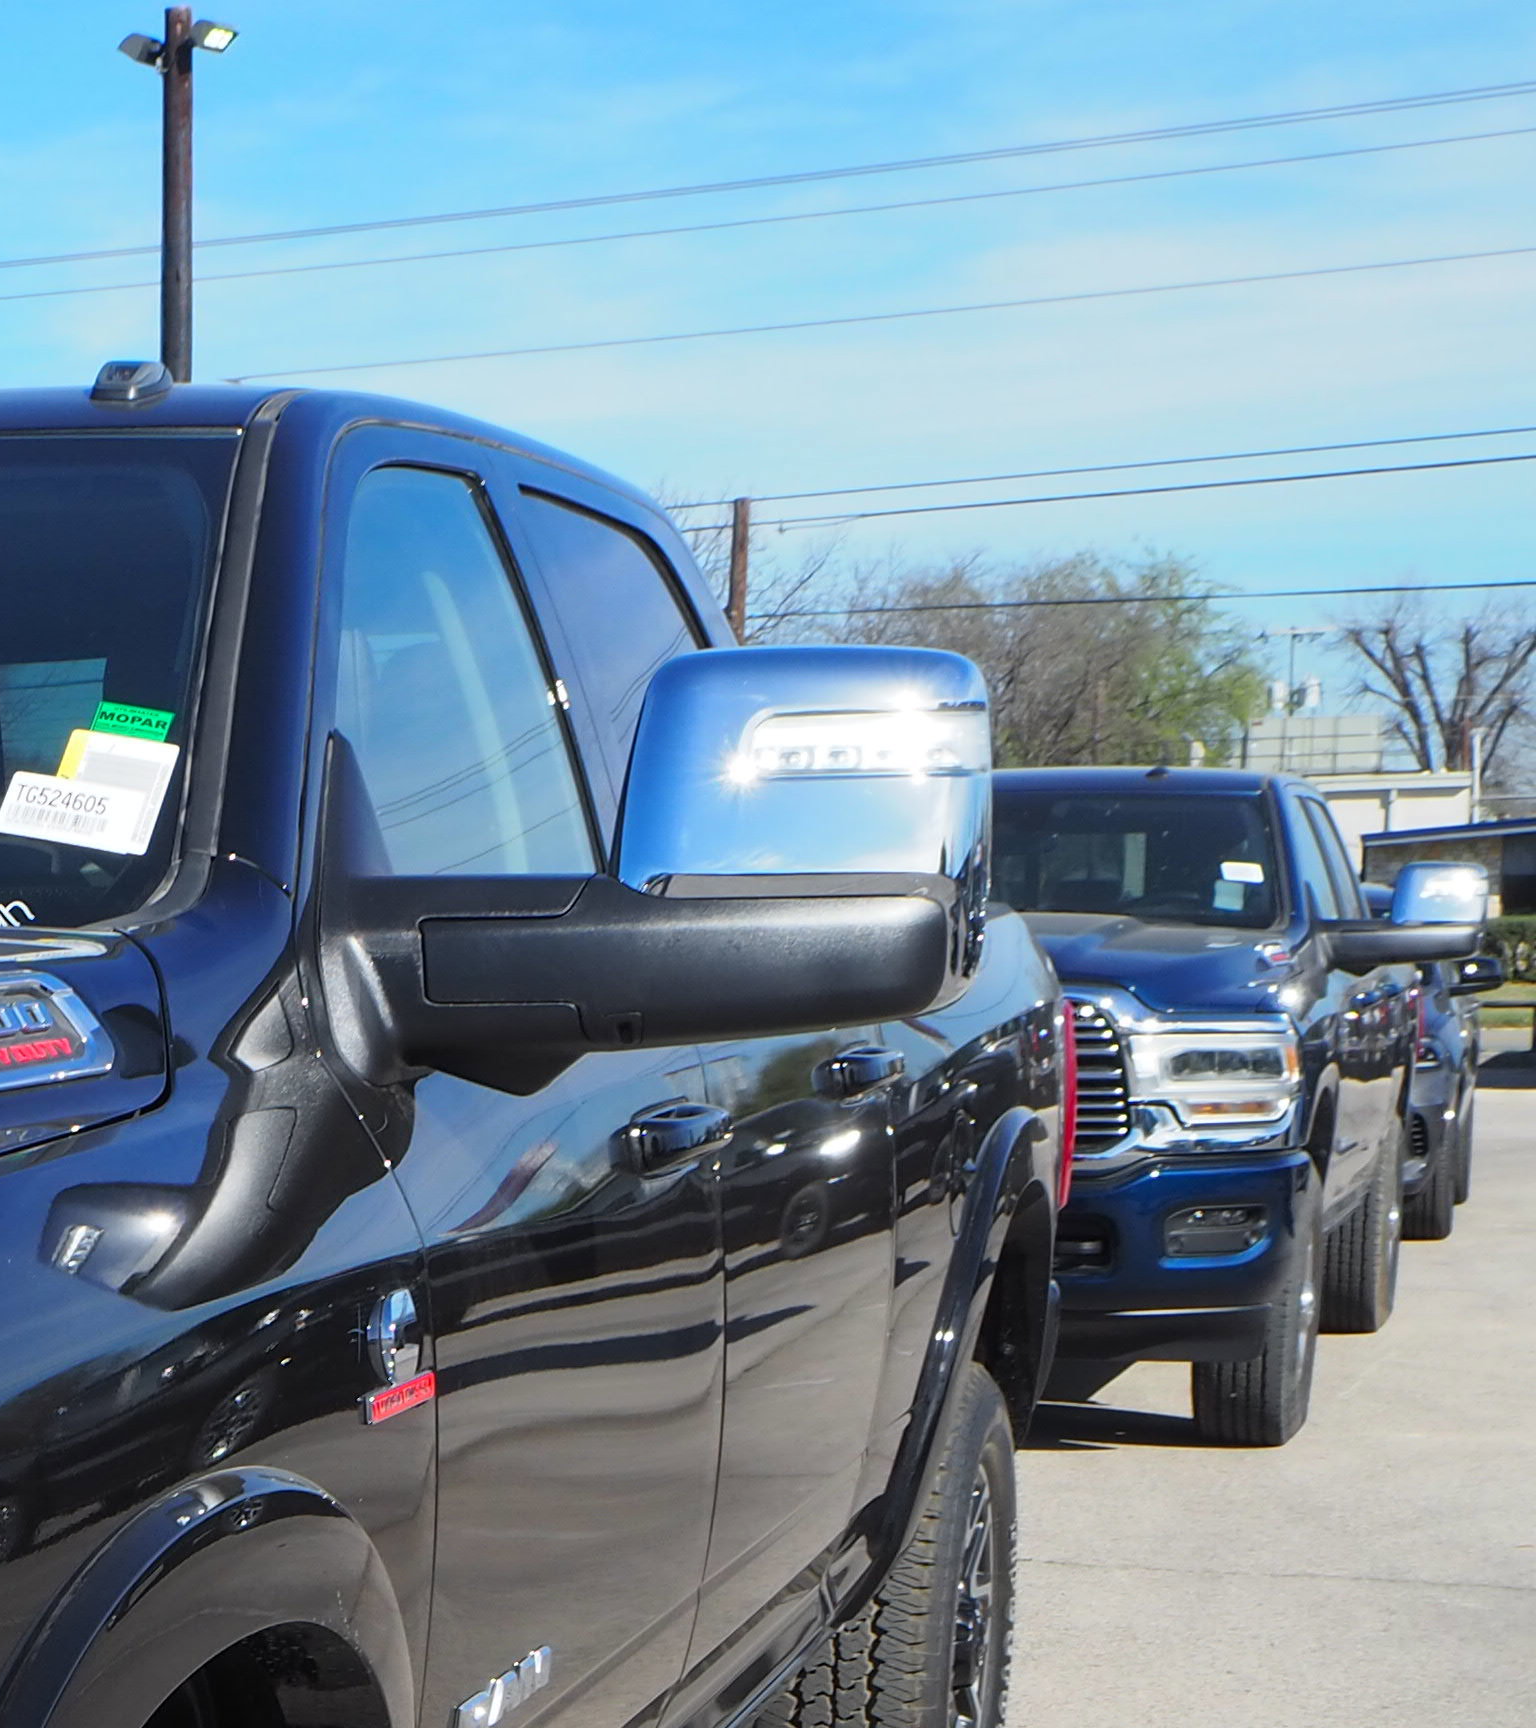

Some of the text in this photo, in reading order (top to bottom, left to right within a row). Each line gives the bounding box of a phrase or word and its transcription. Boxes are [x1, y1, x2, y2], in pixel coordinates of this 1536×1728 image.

[99, 711, 168, 730] MOPAR
[16, 783, 110, 815] TG524605
[16, 1037, 74, 1063] DUTY
